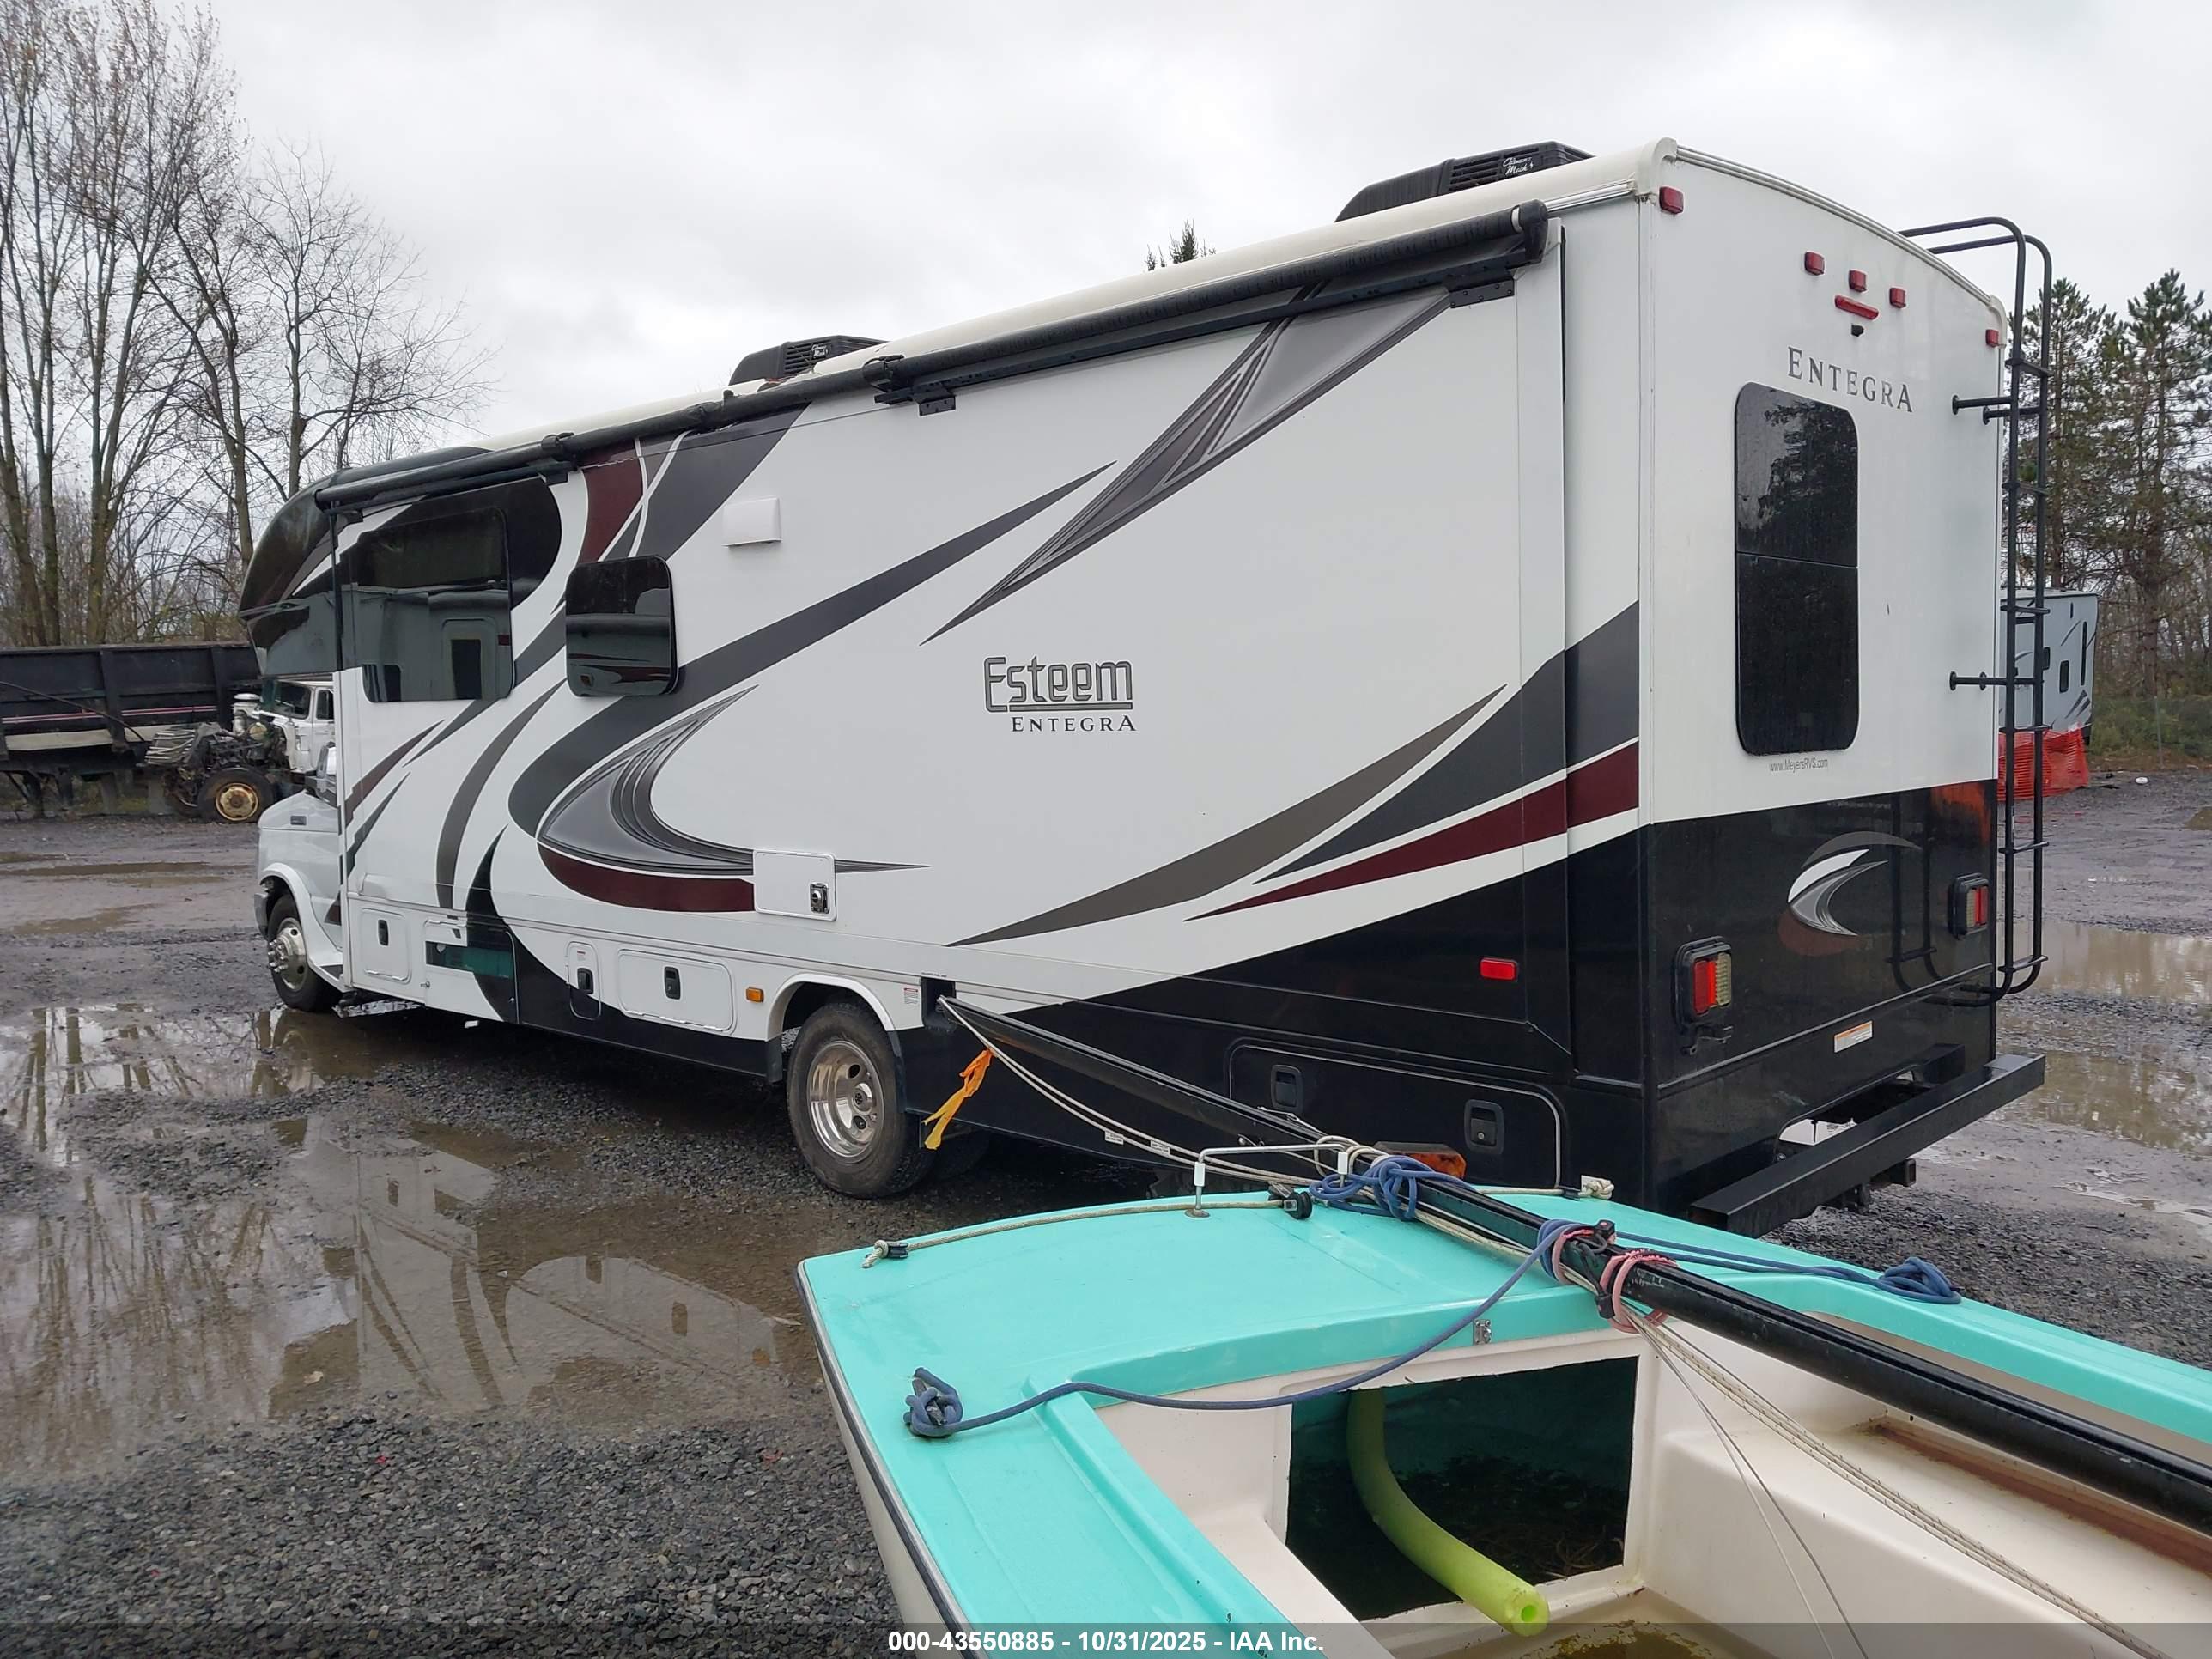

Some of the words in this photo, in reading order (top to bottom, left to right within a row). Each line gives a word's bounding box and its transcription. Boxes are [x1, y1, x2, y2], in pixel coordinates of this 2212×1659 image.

[1787, 345, 1913, 413] ENTEGRA
[983, 655, 1133, 713] Esteem
[1011, 714, 1136, 732] ENTEGRA
